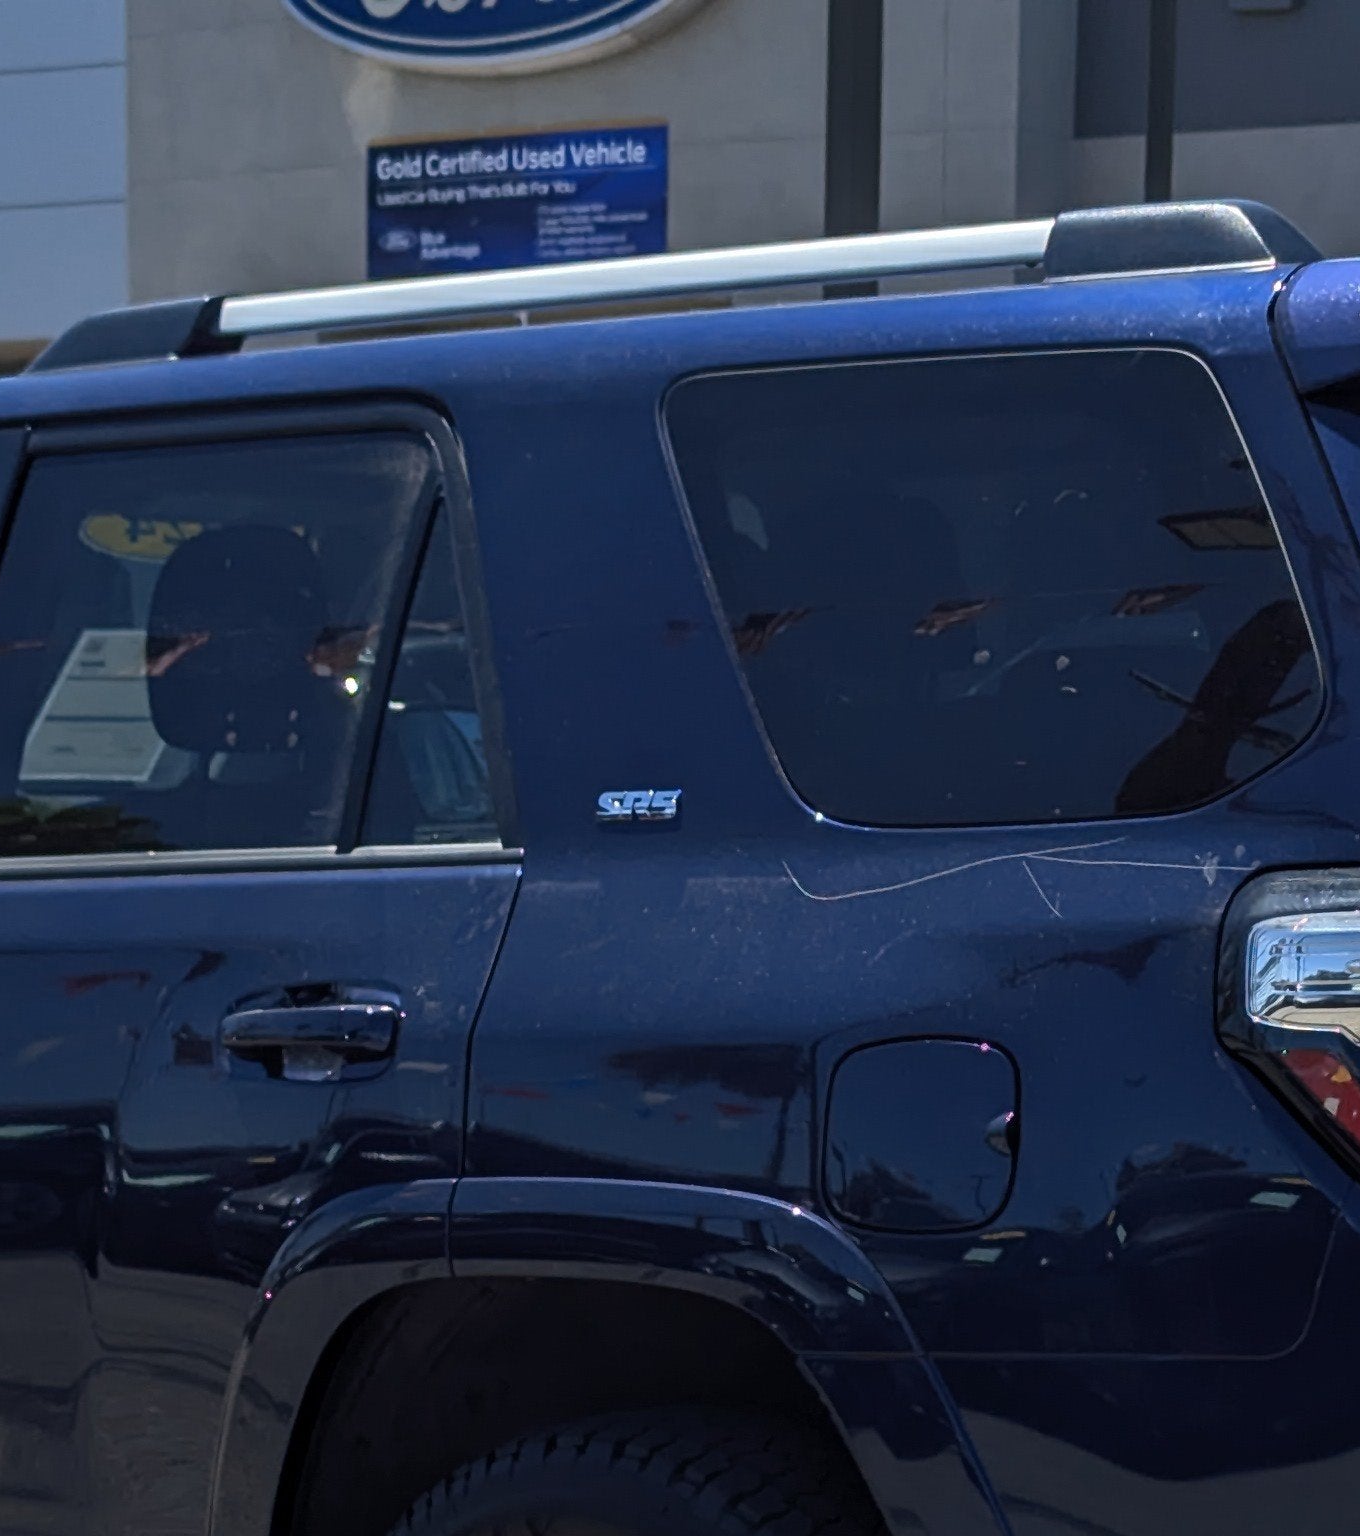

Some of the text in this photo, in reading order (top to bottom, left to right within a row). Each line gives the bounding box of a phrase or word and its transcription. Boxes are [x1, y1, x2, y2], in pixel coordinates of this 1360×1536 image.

[376, 137, 646, 181] Gold Certified Used Vehicle
[596, 789, 683, 821] SR5
